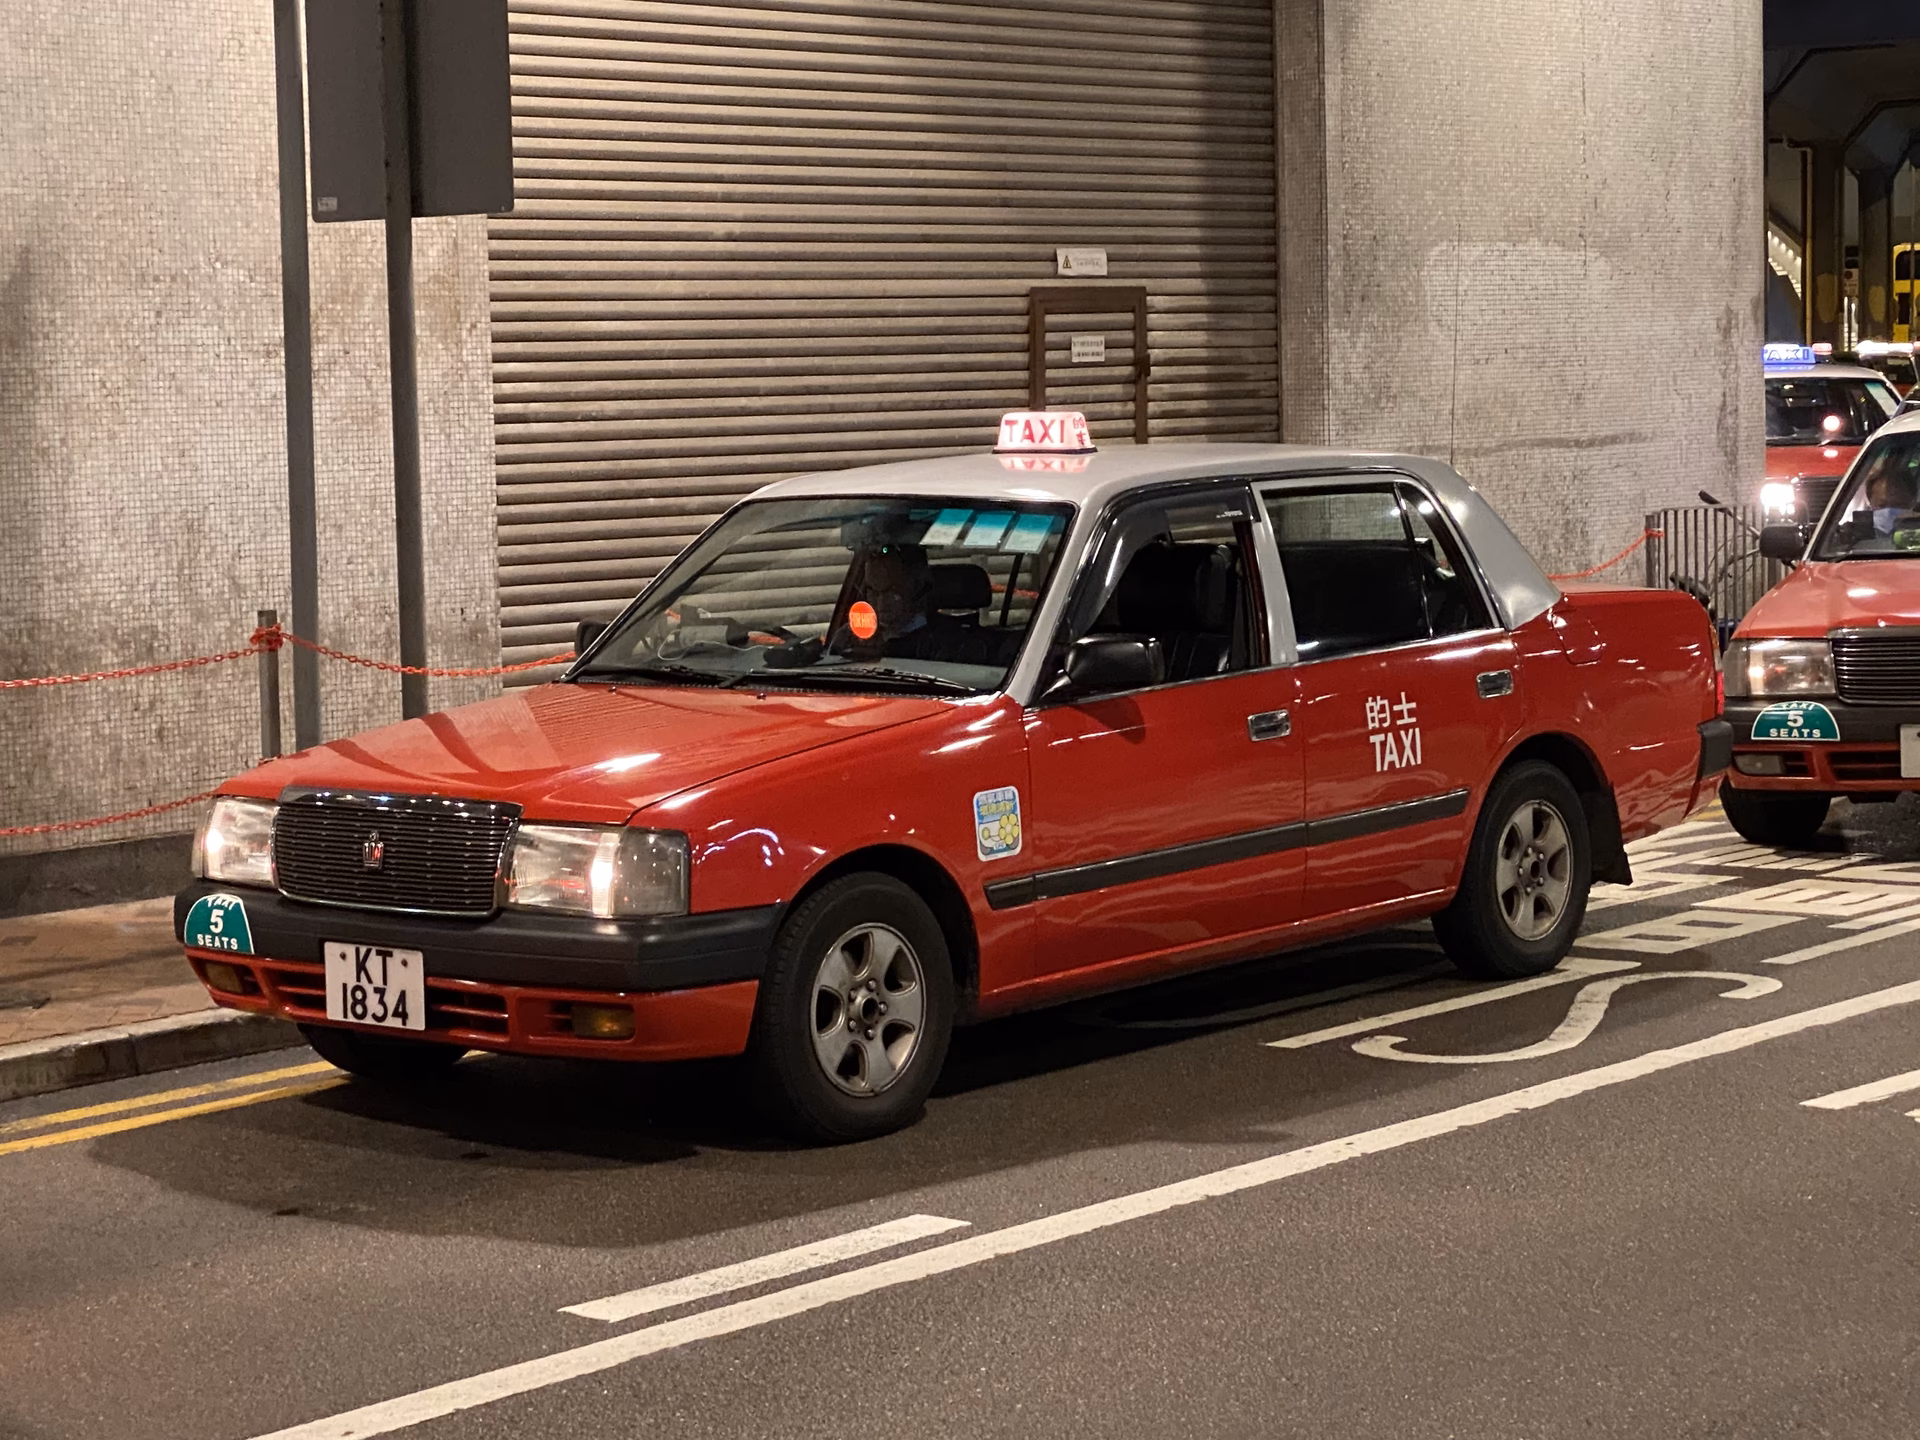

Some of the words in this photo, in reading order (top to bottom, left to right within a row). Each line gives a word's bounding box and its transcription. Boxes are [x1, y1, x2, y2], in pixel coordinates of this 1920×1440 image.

[1004, 419, 1065, 443] TAXI
[1365, 691, 1417, 730] 的士
[1781, 701, 1816, 711] TAXI
[1786, 710, 1804, 728] 5
[1769, 727, 1821, 738] SEATS
[1369, 727, 1422, 773] TAXI
[206, 896, 237, 911] TAXI
[209, 909, 225, 934] 5
[197, 934, 238, 950] SEATS
[355, 946, 394, 986] KT
[342, 982, 409, 1027] 1834
